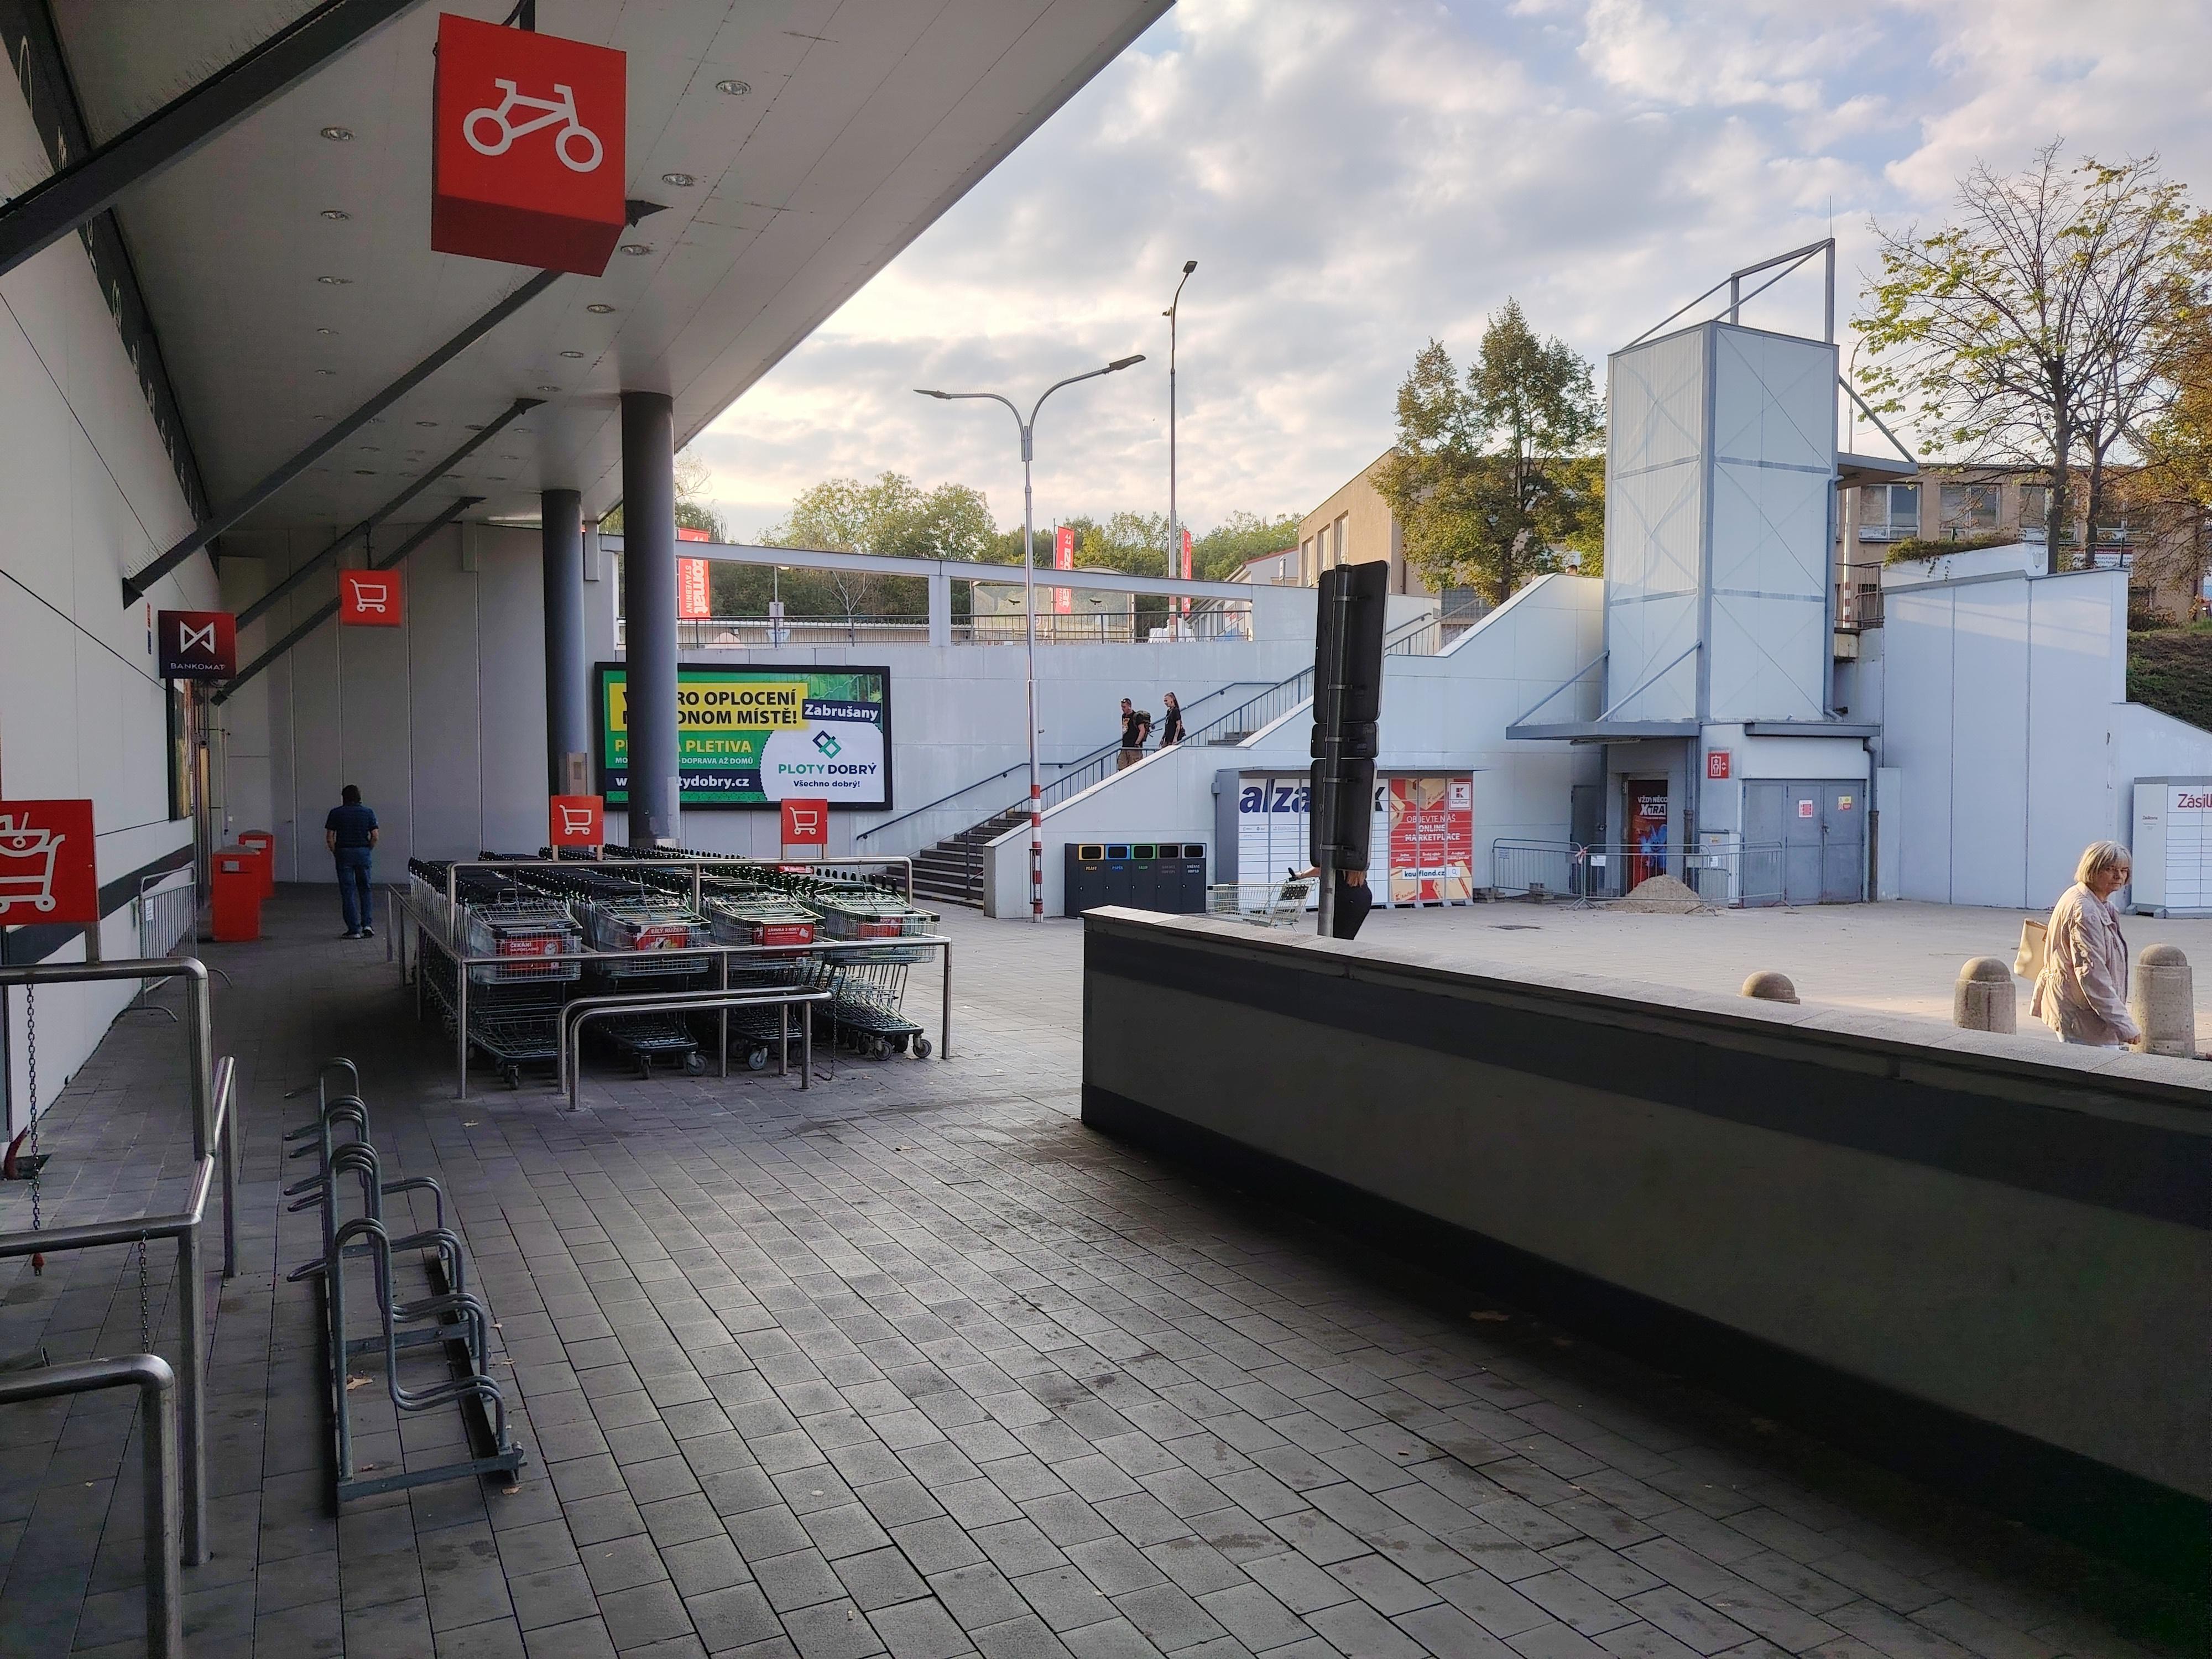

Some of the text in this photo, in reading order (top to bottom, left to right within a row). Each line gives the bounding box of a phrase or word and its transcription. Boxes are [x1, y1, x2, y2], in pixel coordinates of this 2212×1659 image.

[705, 688, 796, 705] OPLOCENÍ
[737, 708, 797, 724] MÍSTĚ!
[805, 704, 879, 721] Zabrušany
[686, 740, 752, 753] PLETIVA
[718, 756, 729, 764] AŽ
[729, 756, 753, 764] DOMŮ
[778, 762, 877, 774] PLOTY DOBRÝ
[832, 780, 860, 789] dobrý!
[2178, 793, 2212, 808] Zásil
[1440, 813, 1456, 822] NÁŠ
[1418, 824, 1446, 832] ONLINE
[1405, 833, 1460, 842] MARKETPLACE
